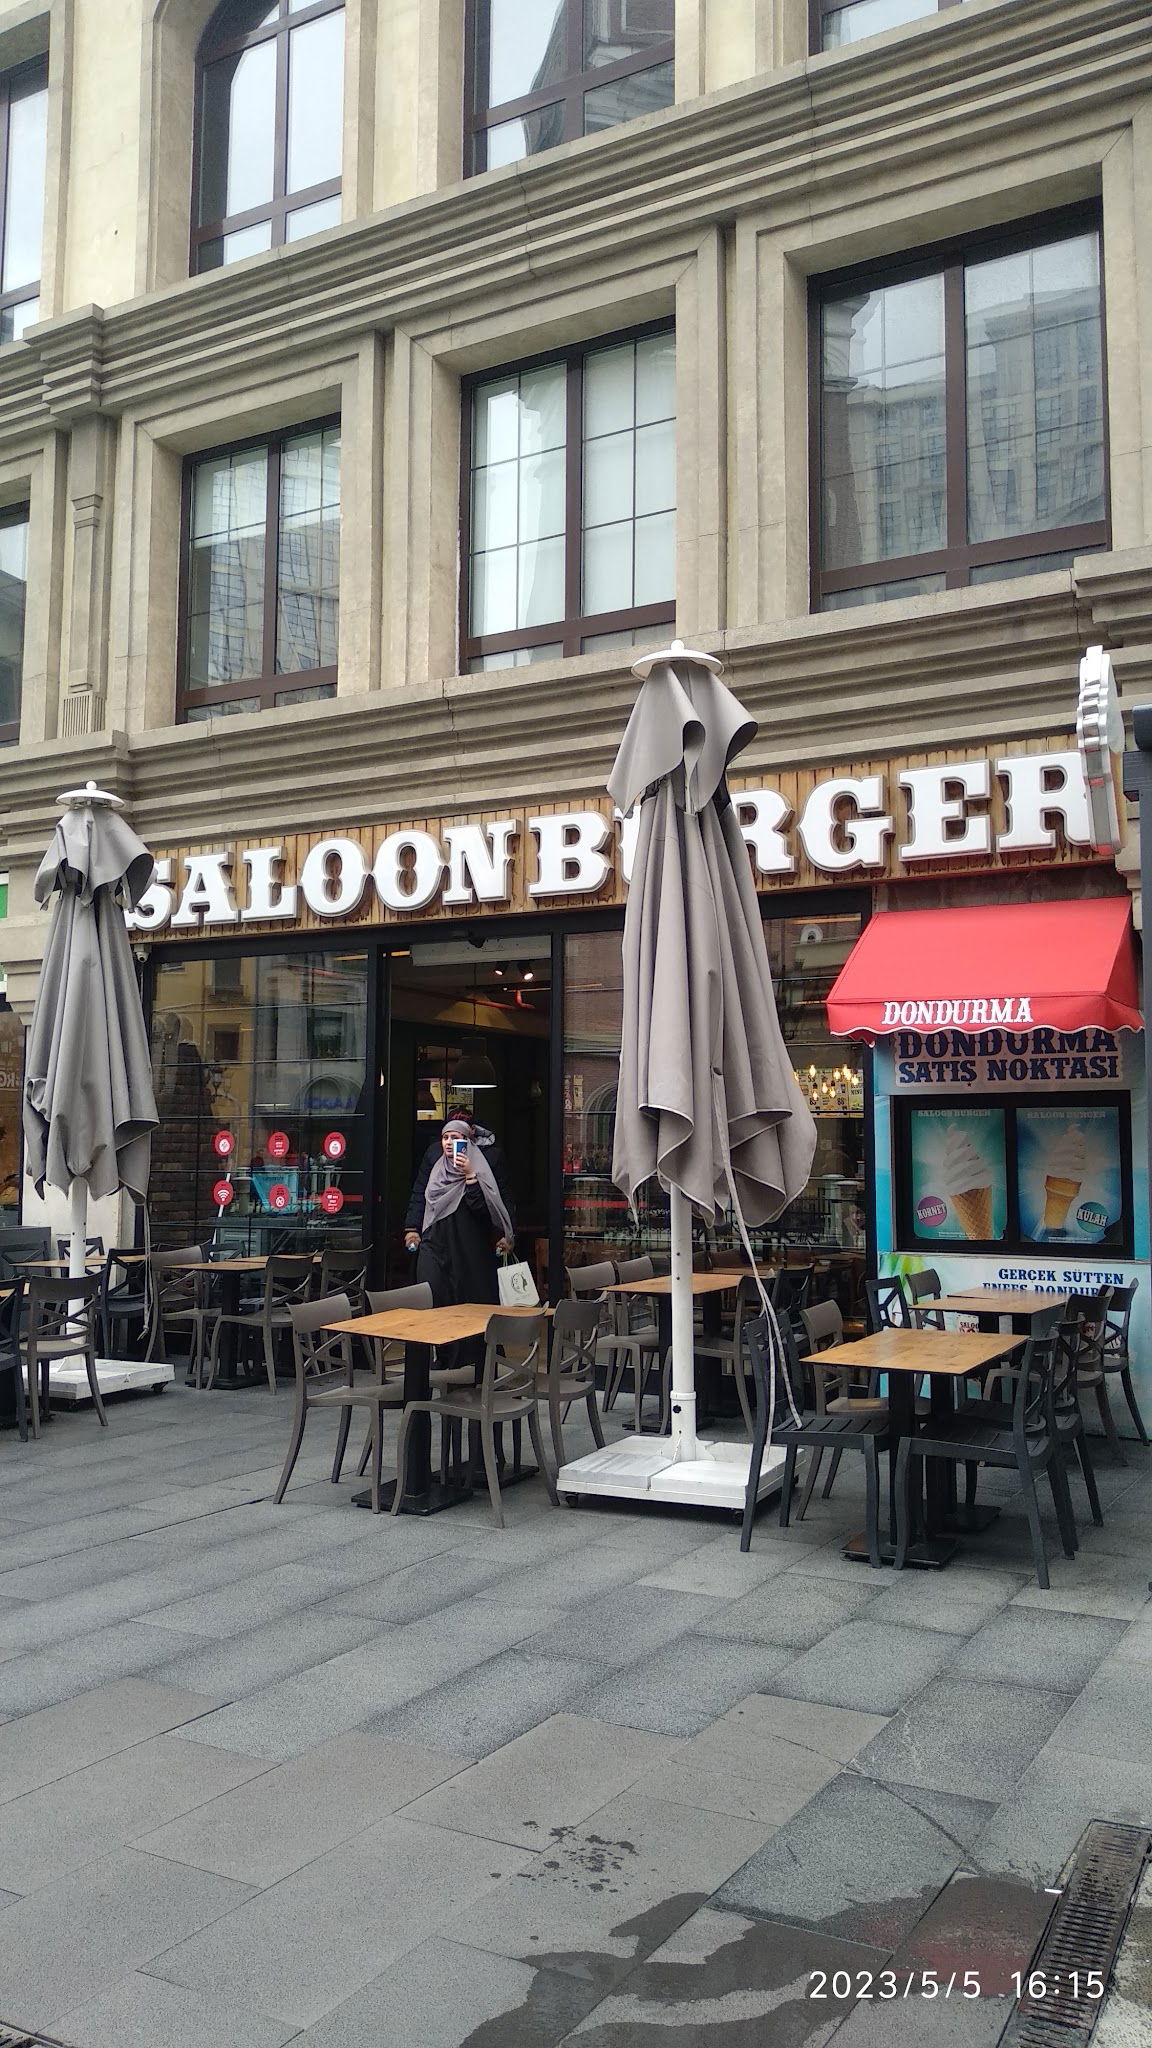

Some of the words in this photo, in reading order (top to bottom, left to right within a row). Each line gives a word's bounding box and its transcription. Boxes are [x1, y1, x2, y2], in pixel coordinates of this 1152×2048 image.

[882, 998, 1033, 1025] DONDURMA
[898, 1028, 1118, 1058] DONDURMA
[986, 1056, 1119, 1081] NOKTASI
[917, 1203, 946, 1220] KORNET
[1076, 1208, 1108, 1227] KÜLAH
[998, 1268, 1057, 1283] GERÇEK
[1063, 1268, 1124, 1285] SÜTTEN
[1034, 1285, 1099, 1296] DONDUR
